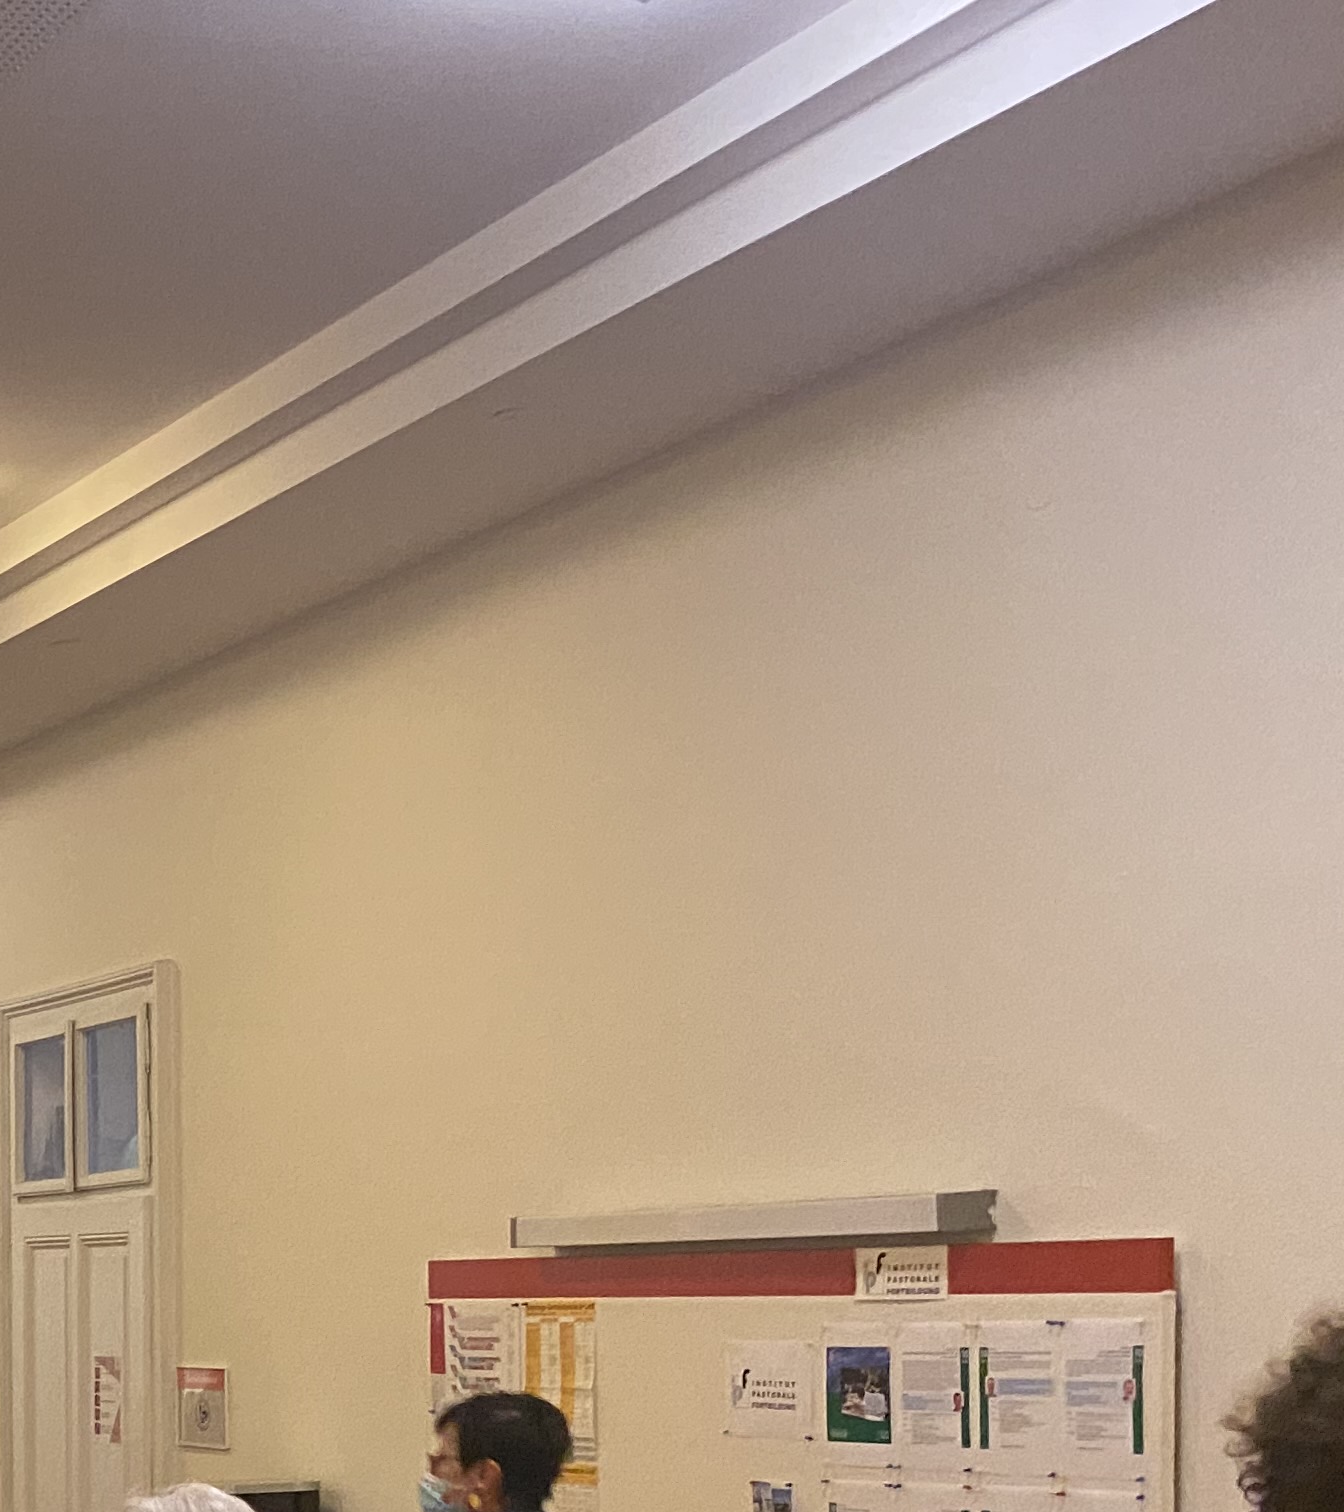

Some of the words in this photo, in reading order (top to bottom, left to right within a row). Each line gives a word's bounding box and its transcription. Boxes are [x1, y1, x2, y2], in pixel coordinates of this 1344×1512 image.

[887, 1263, 939, 1271] INSTITUT
[886, 1275, 940, 1283] PASTORALE
[752, 1380, 796, 1388] INSTITUT
